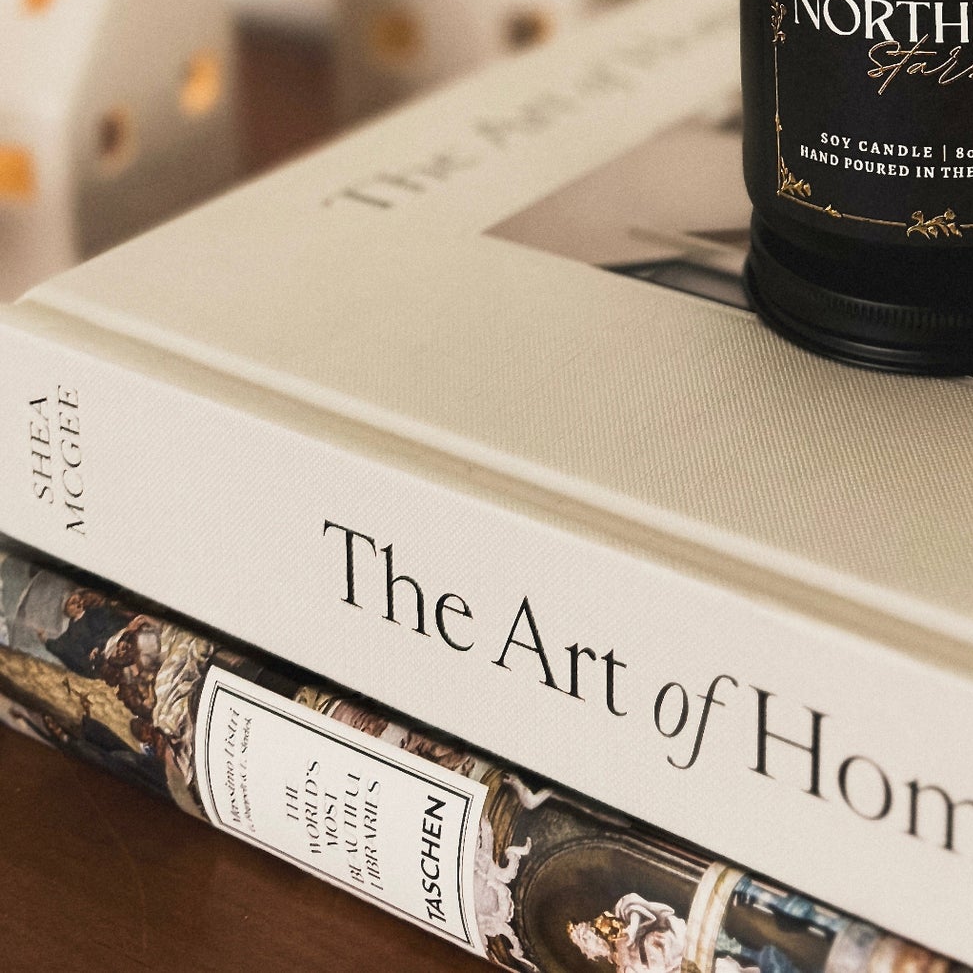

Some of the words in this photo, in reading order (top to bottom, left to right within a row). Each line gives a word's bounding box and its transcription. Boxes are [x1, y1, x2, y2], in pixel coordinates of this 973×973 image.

[800, 145, 839, 167] HAND
[844, 157, 910, 177] POURED
[916, 166, 935, 178] IN
[820, 132, 851, 149] SOY
[858, 140, 933, 158] CANDLE
[29, 396, 54, 504] SHEA
[57, 384, 86, 536] MCGEE
[323, 519, 475, 653] The
[491, 595, 628, 718] Art
[653, 673, 739, 770] of
[421, 795, 446, 922] TASCHEN
